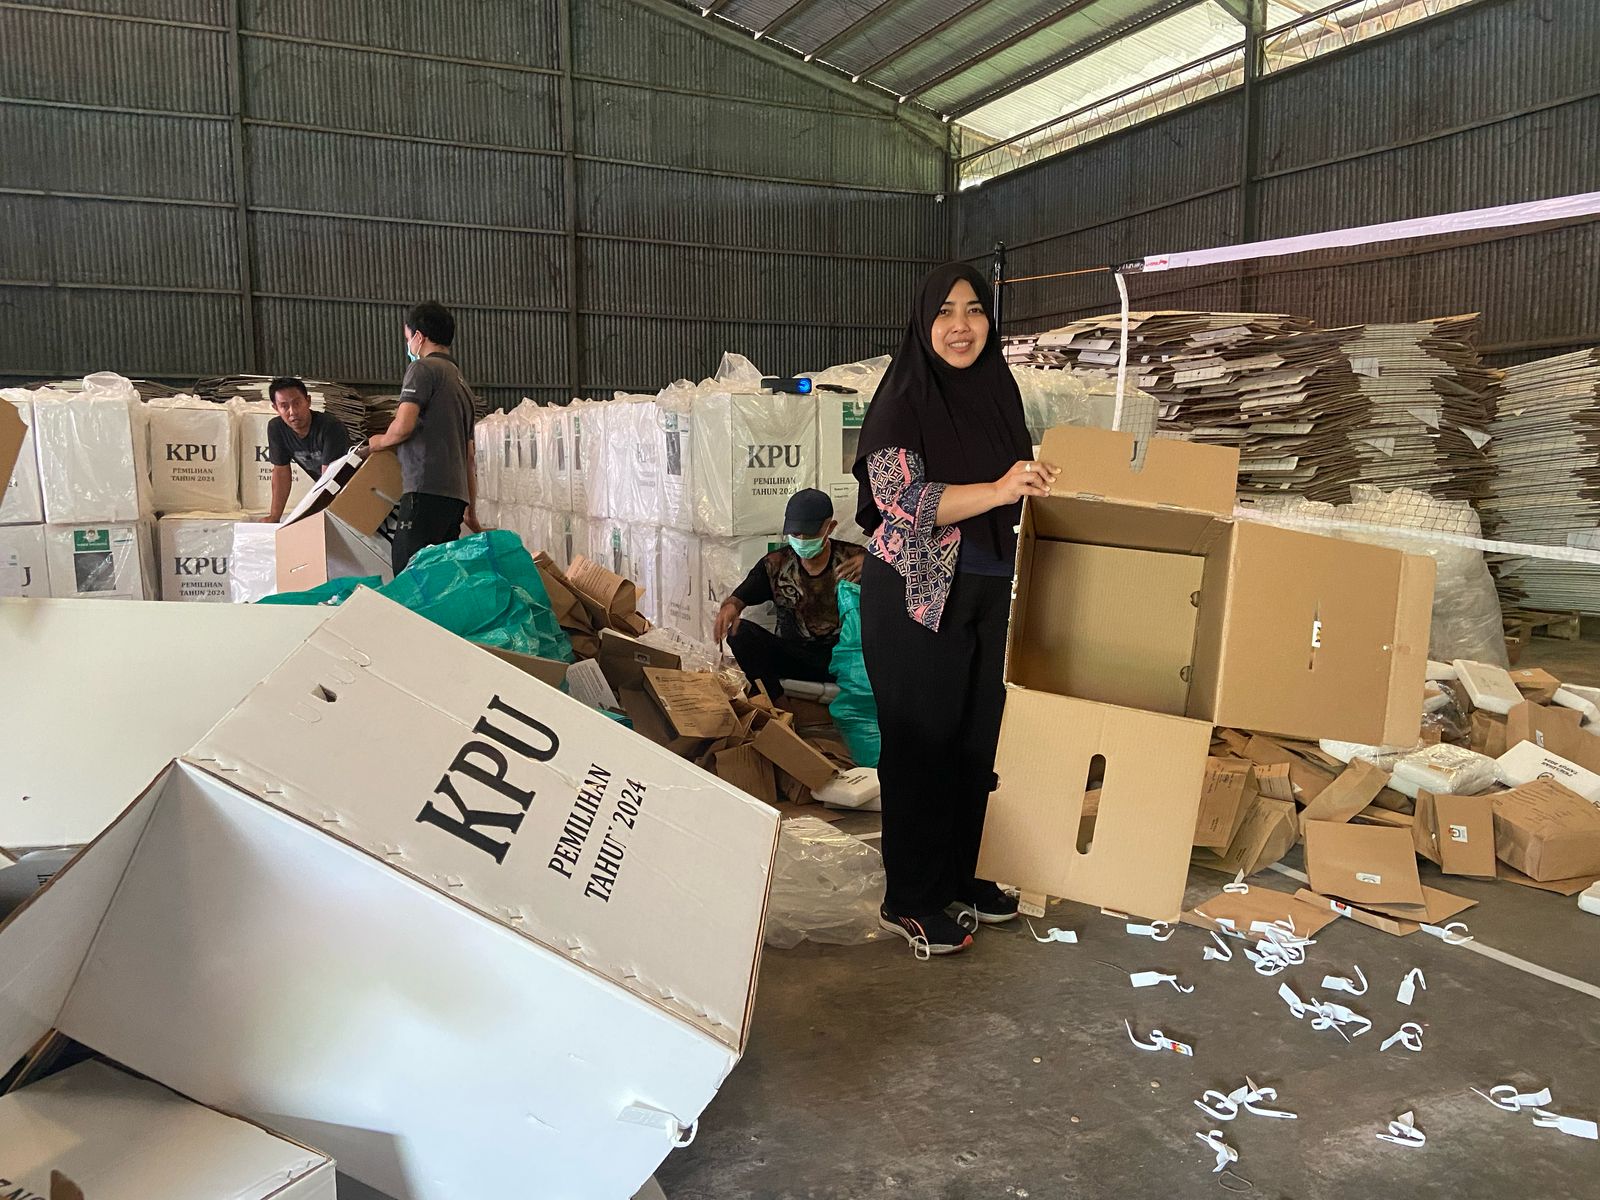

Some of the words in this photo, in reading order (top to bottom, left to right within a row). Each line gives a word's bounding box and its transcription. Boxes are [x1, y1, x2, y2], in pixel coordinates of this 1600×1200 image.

[166, 444, 217, 462] KPU
[747, 445, 801, 468] KPU
[753, 477, 796, 485] PEMILIHAN
[752, 487, 778, 496] TAHUN
[174, 557, 227, 575] KPU
[415, 694, 560, 866] KPU
[612, 778, 647, 830] 2024
[548, 763, 611, 879] PEMILIHAN
